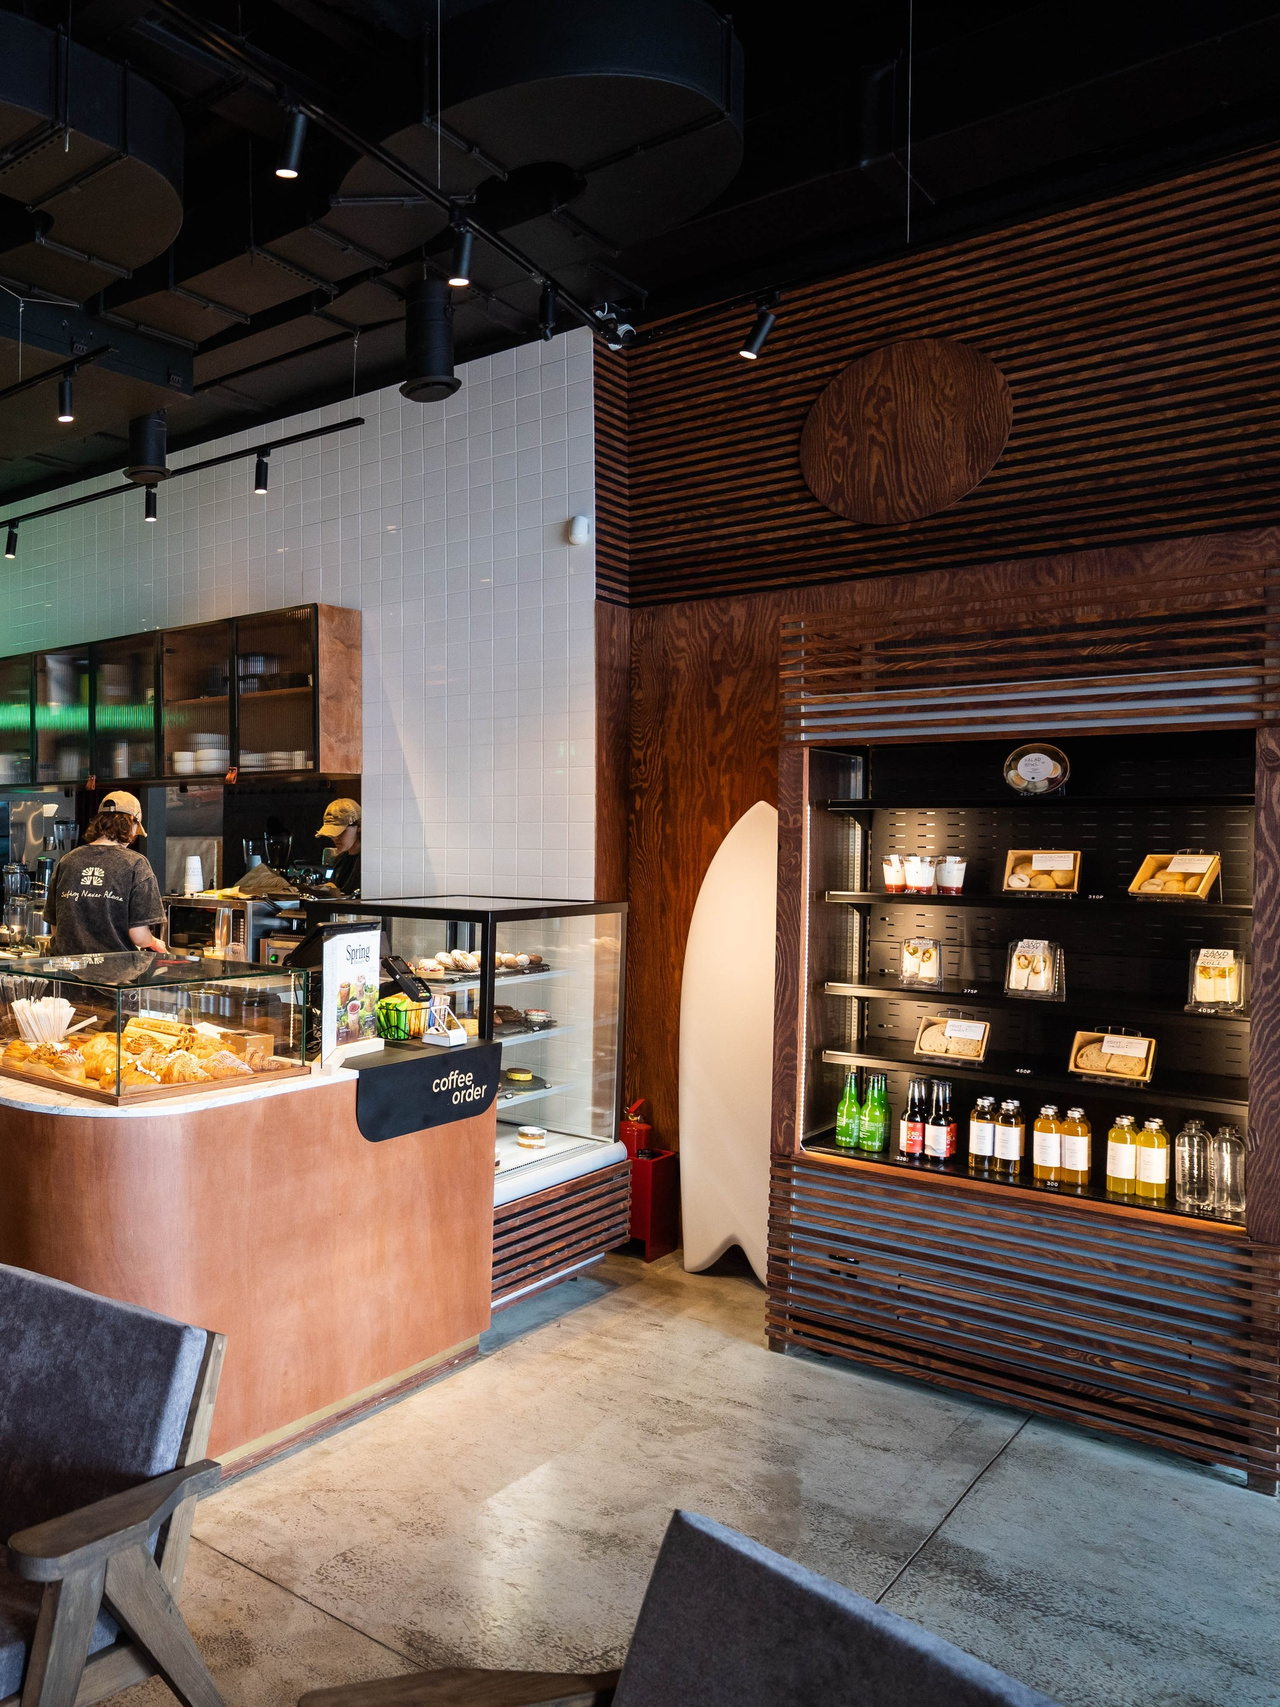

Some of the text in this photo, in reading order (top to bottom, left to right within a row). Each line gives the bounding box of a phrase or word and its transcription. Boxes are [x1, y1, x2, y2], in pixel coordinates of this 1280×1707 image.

[103, 890, 124, 902] Alone
[345, 944, 371, 965] Spring
[432, 1070, 473, 1093] coffee
[452, 1083, 487, 1105] order
